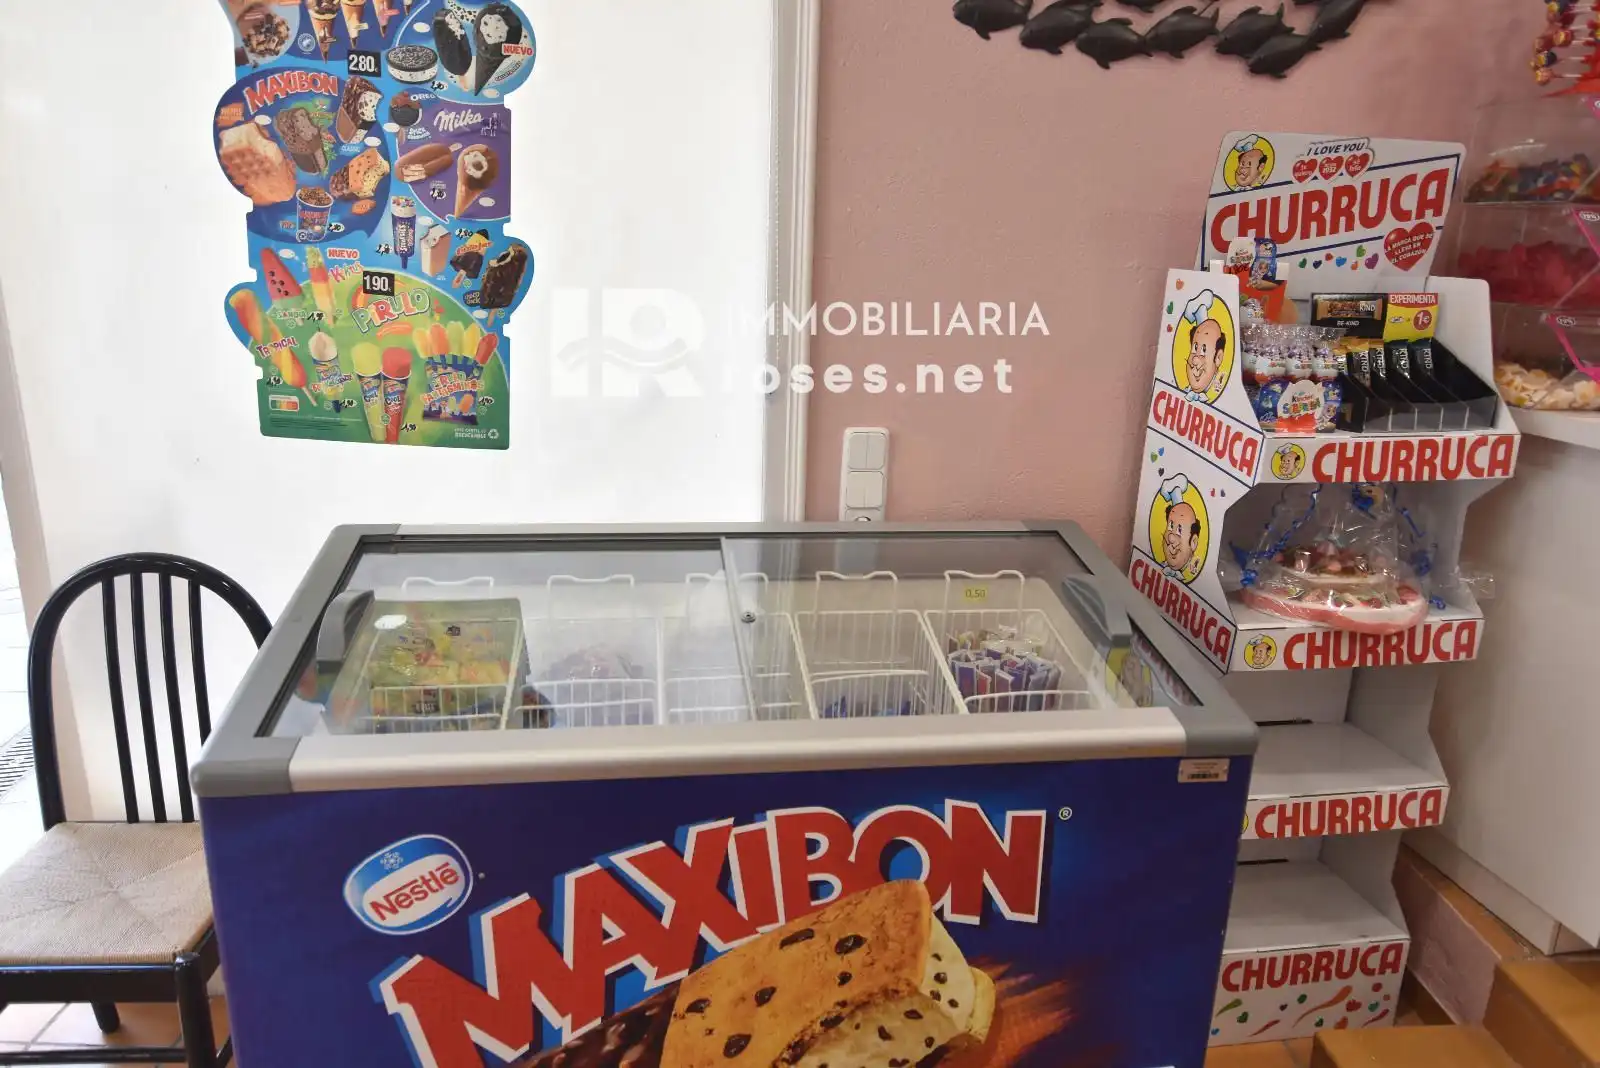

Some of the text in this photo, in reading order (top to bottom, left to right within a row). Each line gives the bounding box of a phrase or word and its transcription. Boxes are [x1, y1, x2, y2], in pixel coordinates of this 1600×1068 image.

[503, 44, 533, 56] NUEVO
[243, 70, 338, 115] MAXIBON
[434, 109, 484, 133] Milka
[1307, 142, 1366, 157] I LOVE YOU
[1210, 168, 1449, 254] CHURRUCA
[328, 249, 359, 259] NUEVO
[351, 288, 432, 333] PIRULO
[1360, 301, 1376, 312] KIND
[1389, 295, 1436, 305] EXPERIMENTA
[256, 336, 299, 359] TRPICAL
[1423, 347, 1433, 369] KIND
[1153, 390, 1259, 477] CHURRUCA
[1311, 434, 1515, 483] CHURRUCA
[1131, 559, 1232, 664] CHURRUCA
[1283, 620, 1477, 670] CHURRUCA
[1255, 789, 1442, 839] CHURRUCA
[369, 861, 460, 921] Nestlé
[380, 798, 1047, 1068] MAXIBON
[1221, 943, 1403, 992] CHURRUCA
